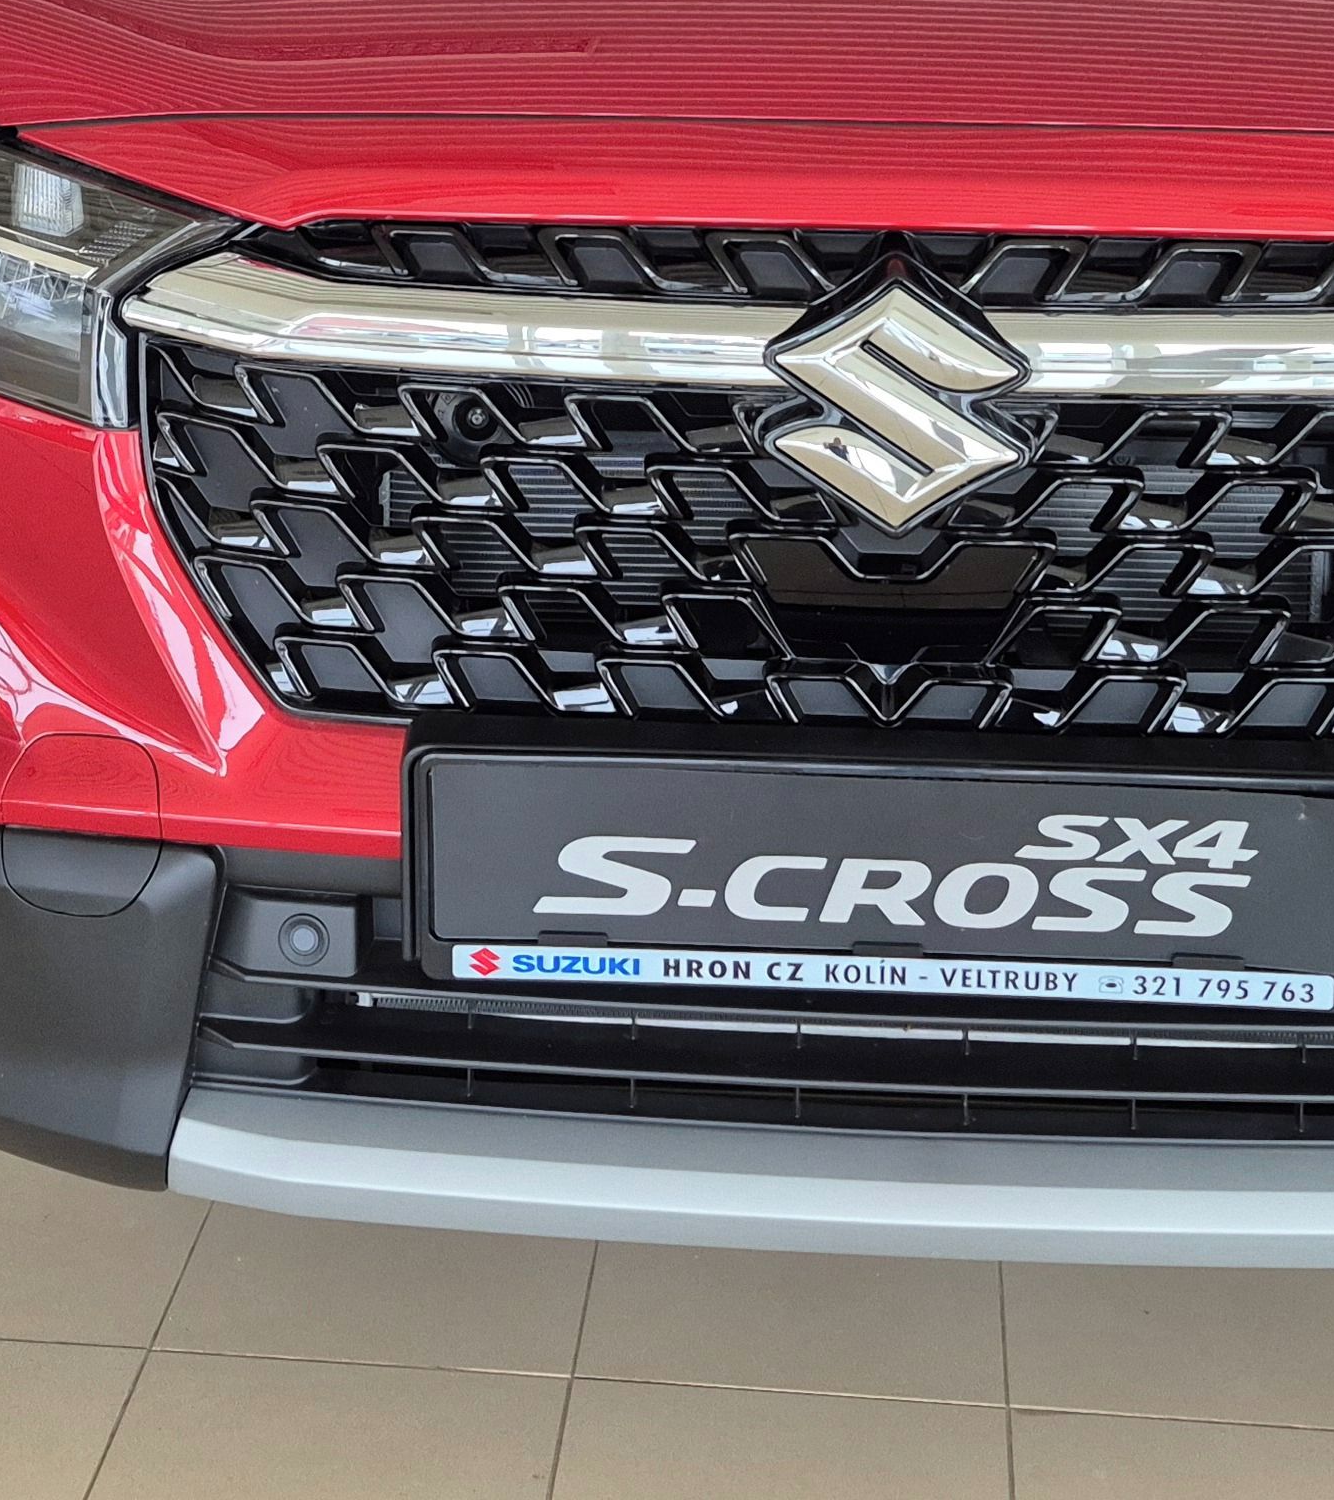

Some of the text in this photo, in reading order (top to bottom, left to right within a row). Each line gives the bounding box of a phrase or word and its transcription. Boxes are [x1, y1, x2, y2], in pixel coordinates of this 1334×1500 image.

[1014, 814, 1260, 870] SX4
[532, 835, 1252, 937] S-CROSS
[512, 954, 641, 976] SUZUKI
[663, 958, 752, 980] HRON
[766, 962, 804, 982] CZ
[825, 960, 907, 986] KOLÍN
[939, 967, 1079, 992] VELTRUBY
[1133, 975, 1182, 997] 321
[1199, 978, 1249, 1000] 795
[1264, 981, 1315, 1003] 763
